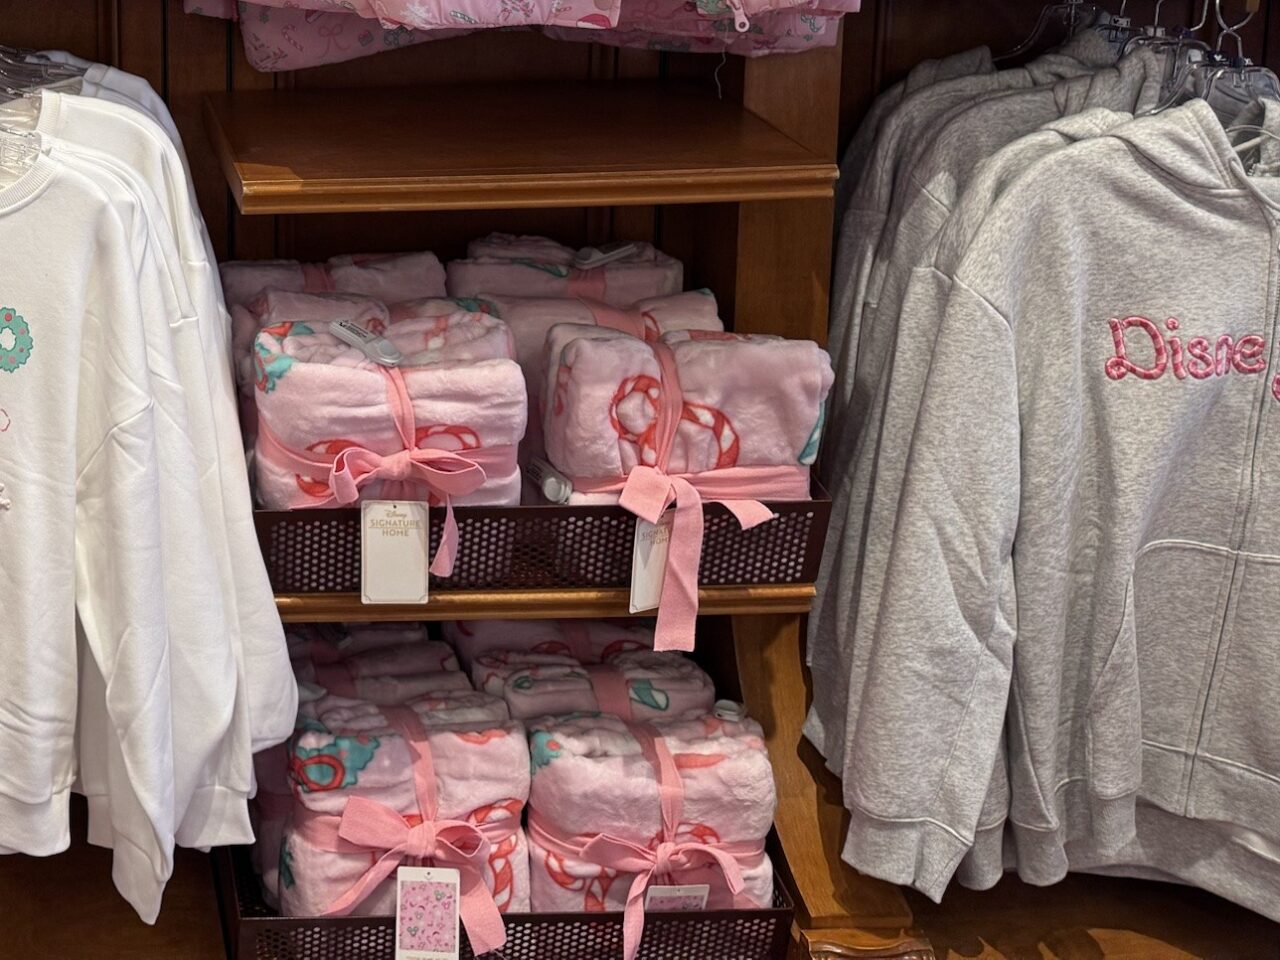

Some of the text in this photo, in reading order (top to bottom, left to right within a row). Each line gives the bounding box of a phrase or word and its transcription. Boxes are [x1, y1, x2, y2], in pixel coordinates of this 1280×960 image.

[1104, 316, 1280, 402] Disne
[384, 509, 407, 519] Disney
[369, 519, 421, 528] SIGNATURE
[382, 529, 409, 537] HOME
